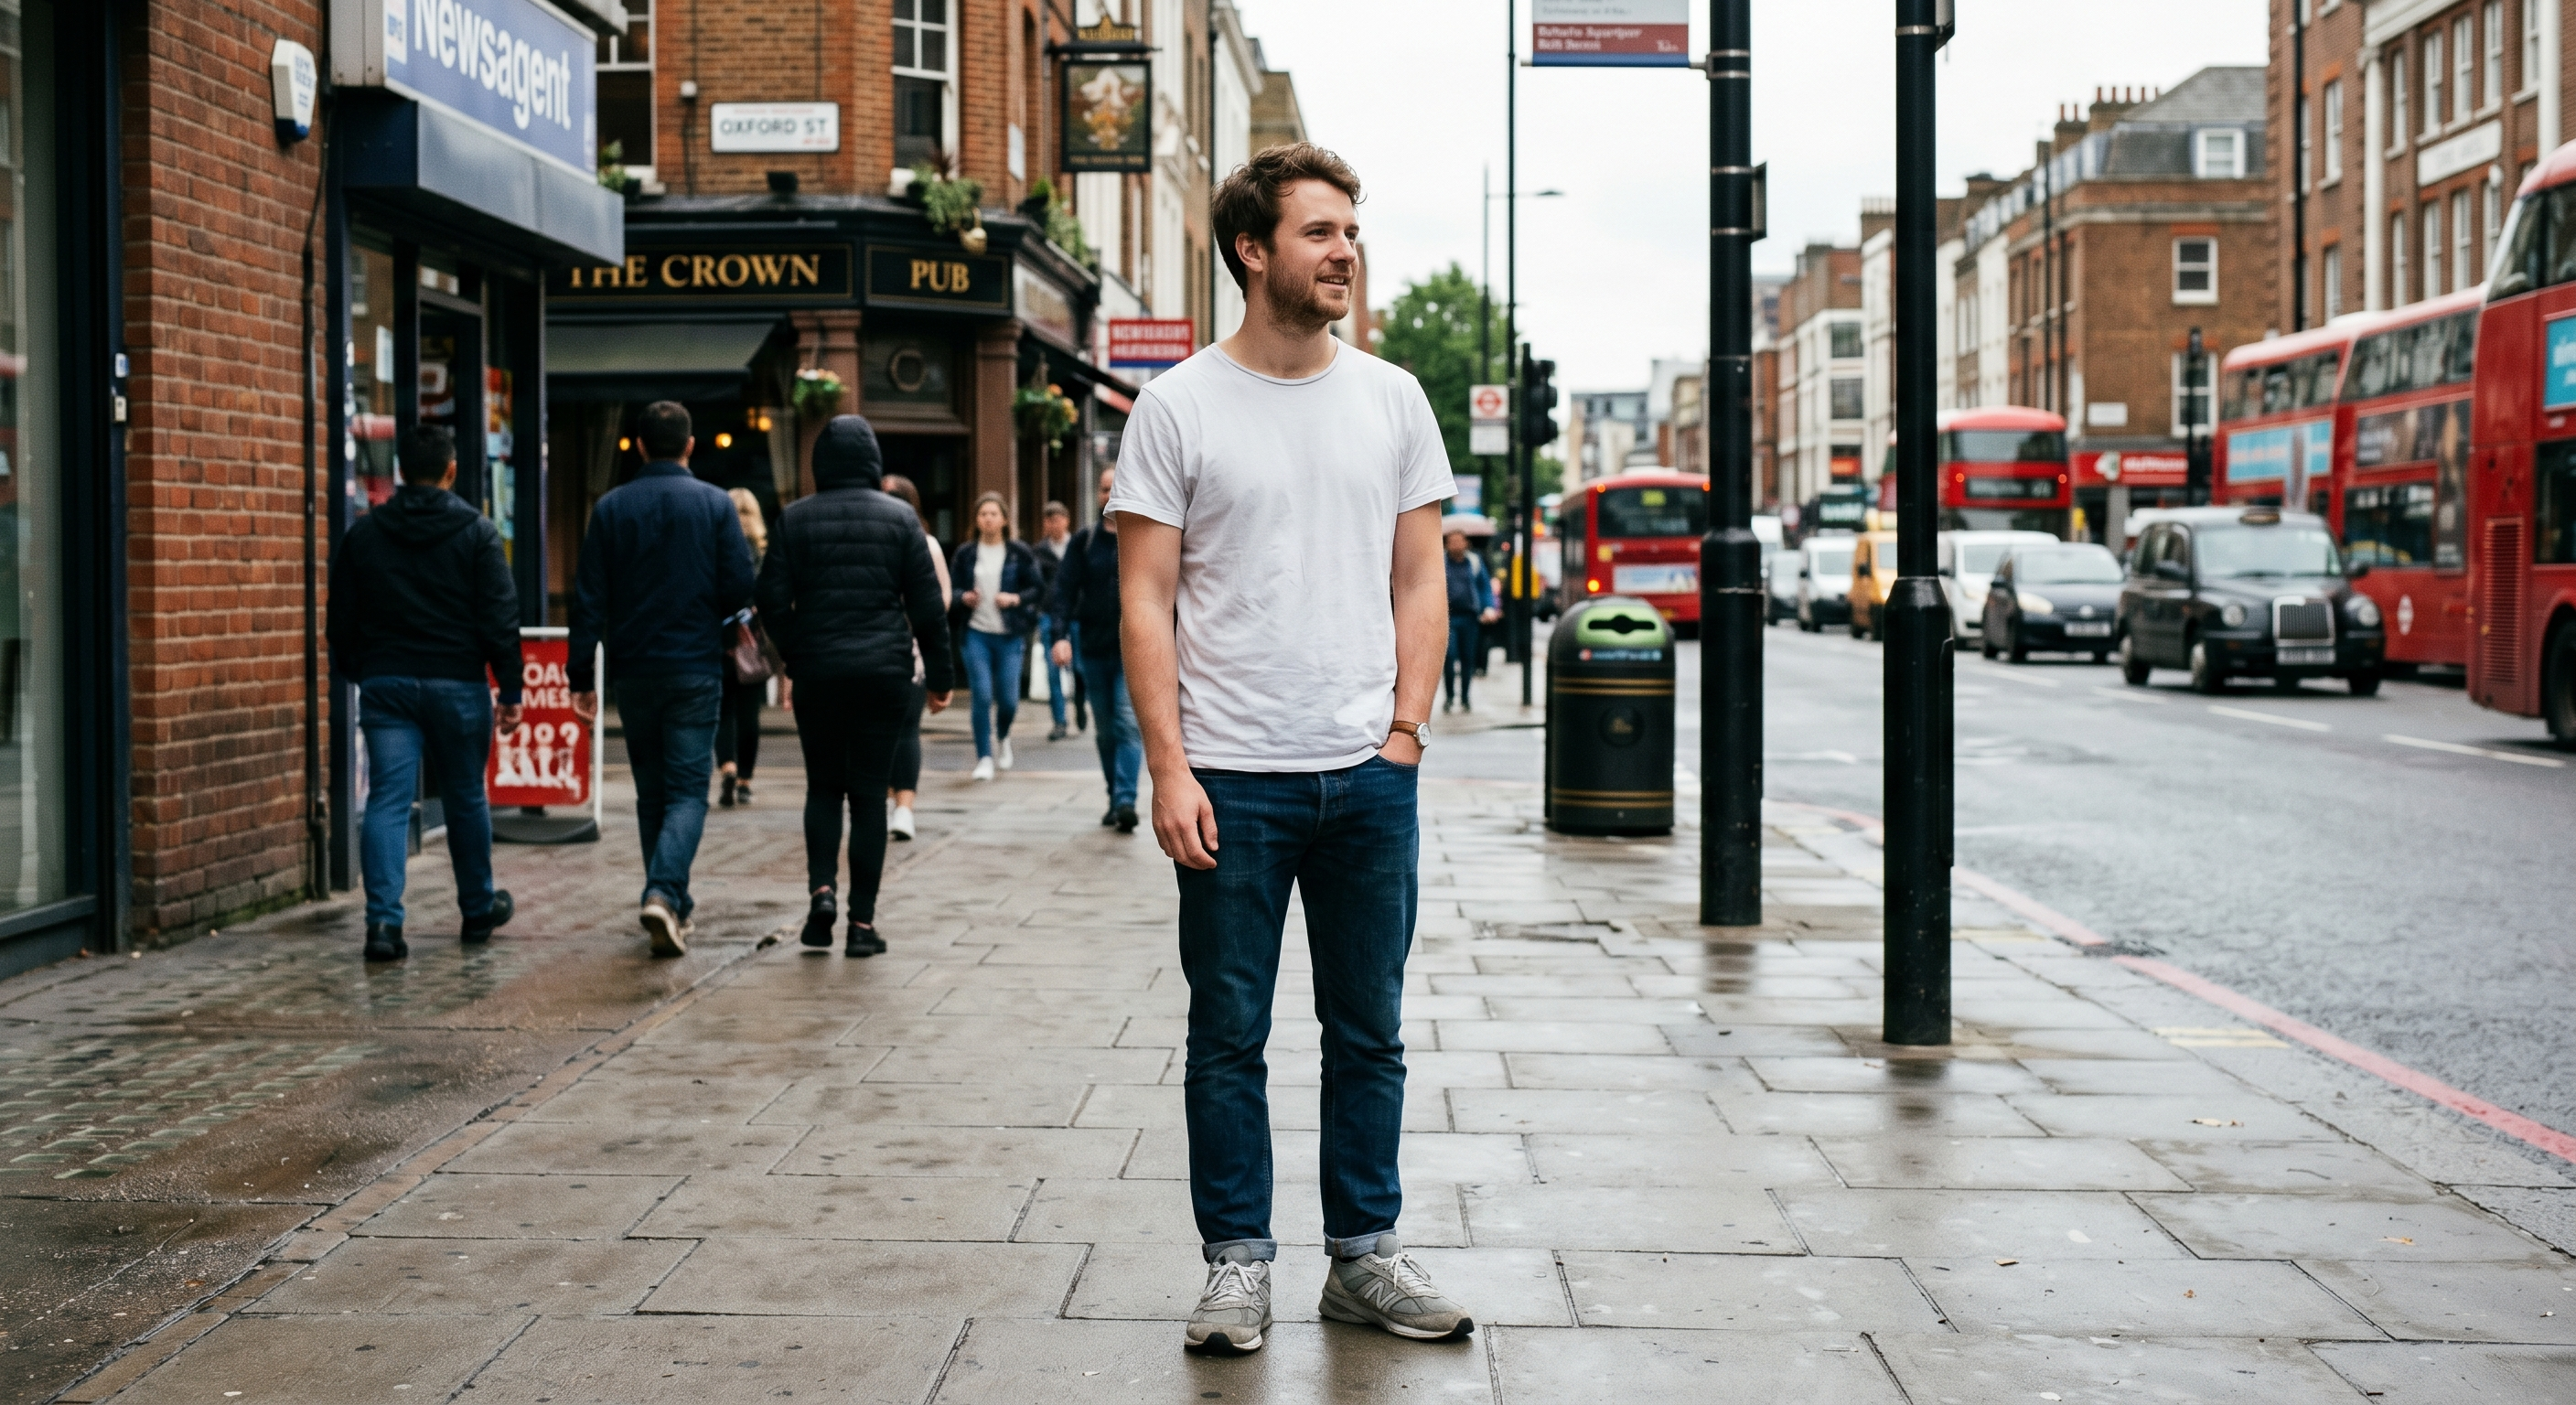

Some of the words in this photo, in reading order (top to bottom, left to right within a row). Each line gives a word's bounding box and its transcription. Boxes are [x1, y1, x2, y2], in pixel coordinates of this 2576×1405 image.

[414, 0, 572, 131] Newsagent
[719, 118, 798, 135] OXFORD
[804, 117, 828, 135] ST
[660, 253, 821, 288] CROWN
[909, 259, 971, 294] PUB
